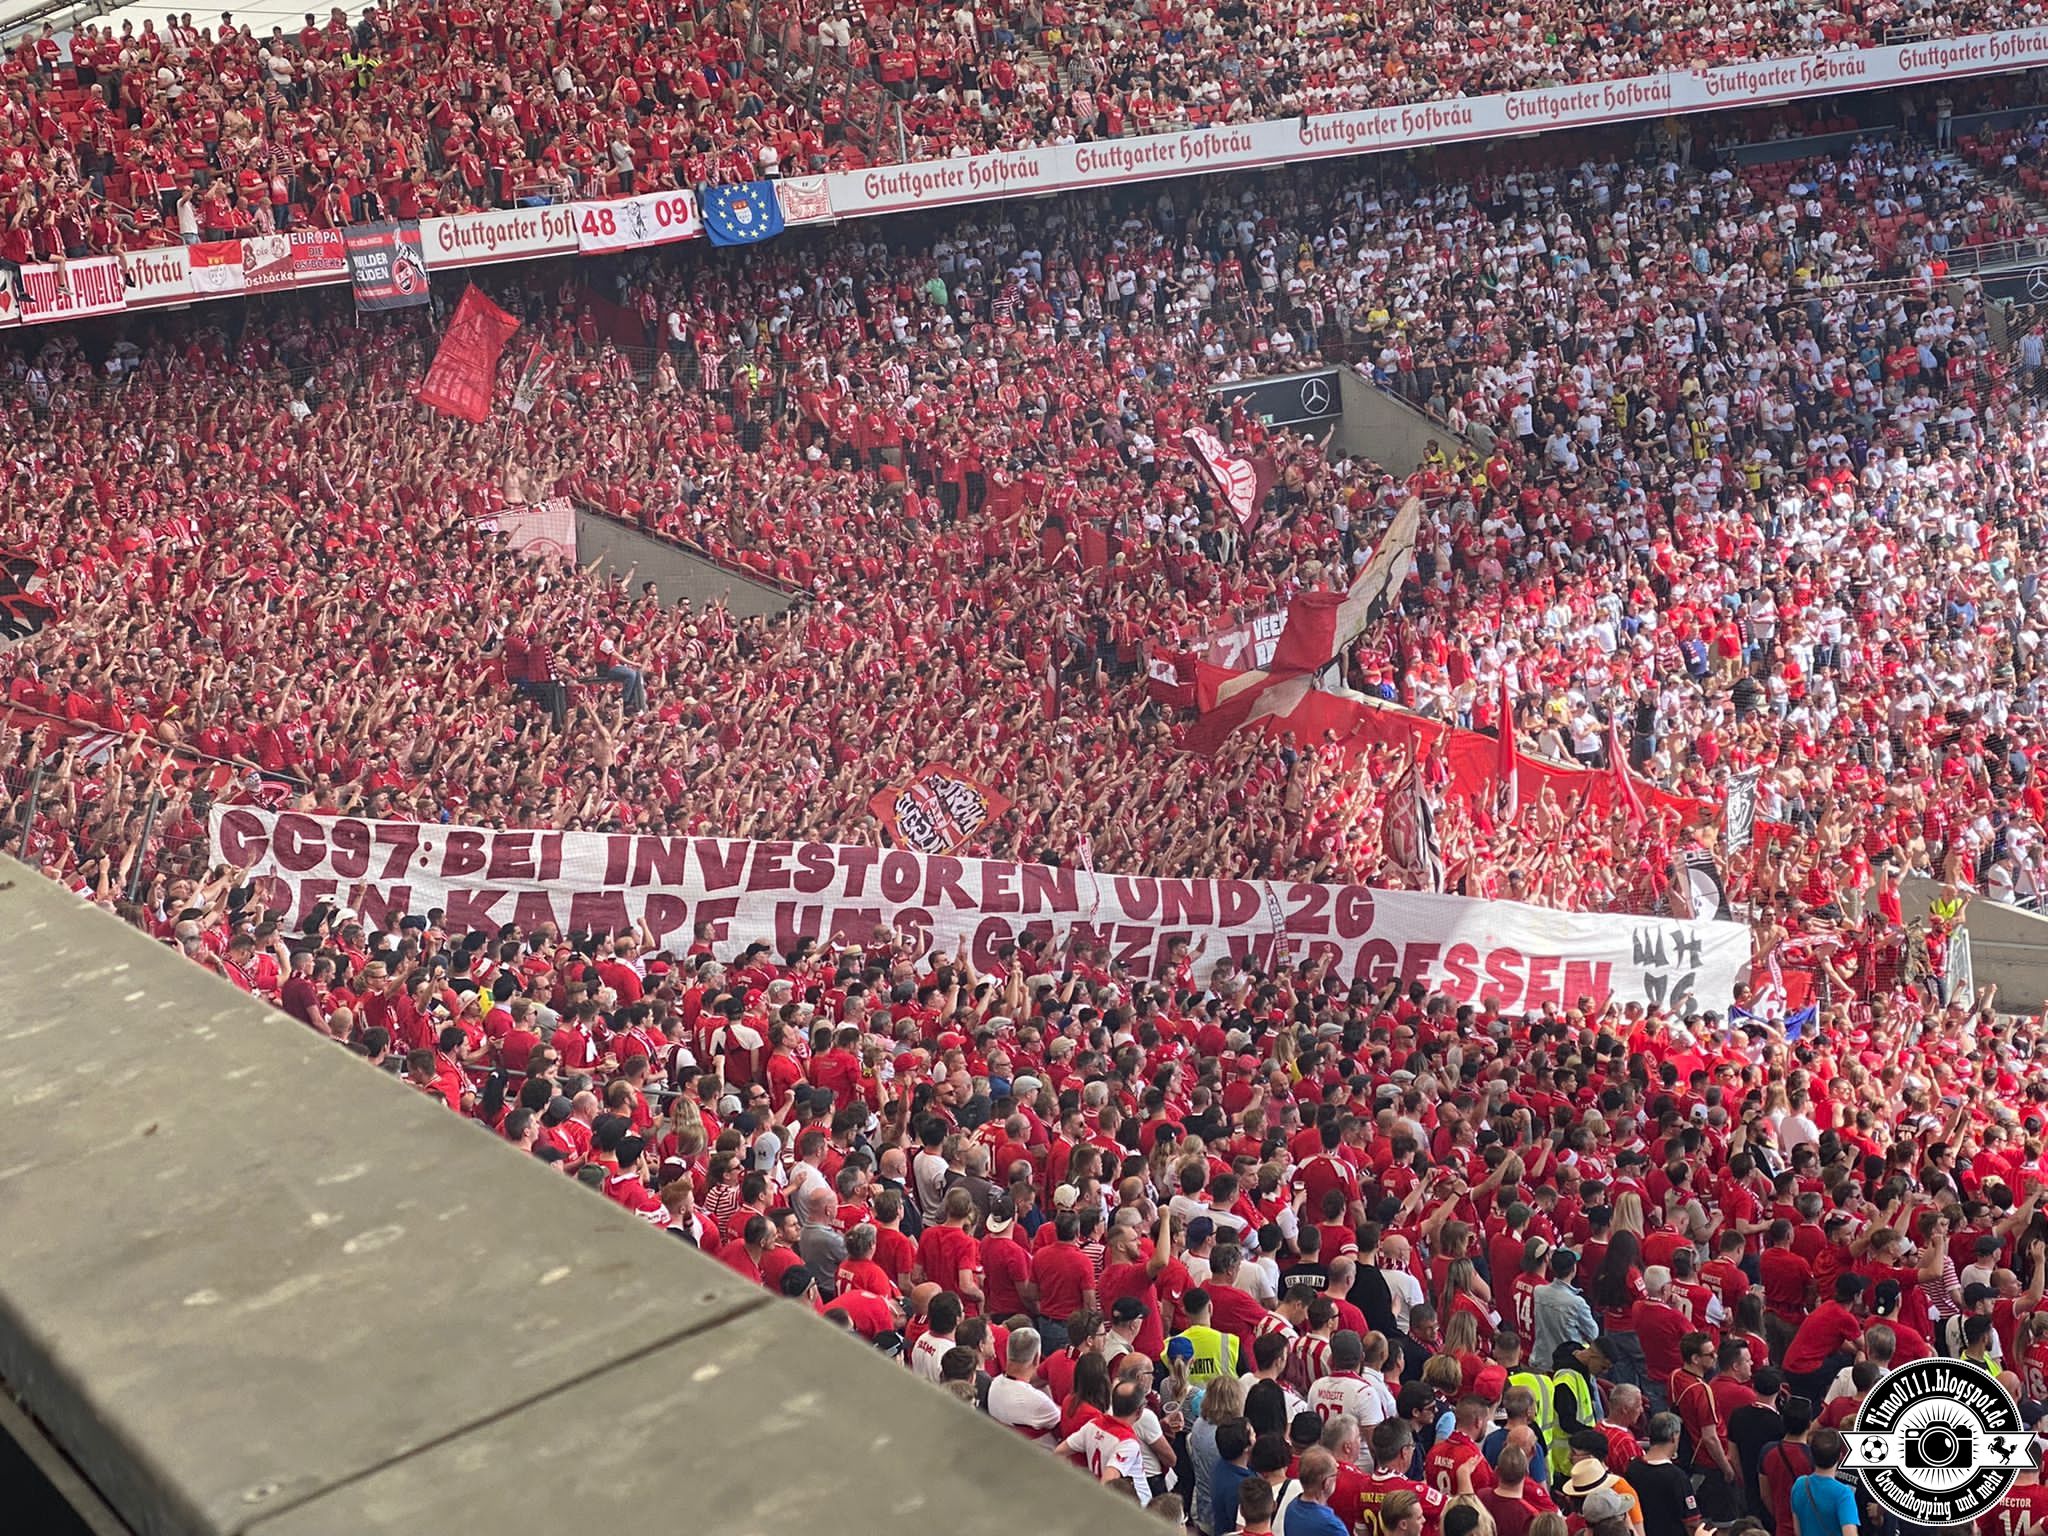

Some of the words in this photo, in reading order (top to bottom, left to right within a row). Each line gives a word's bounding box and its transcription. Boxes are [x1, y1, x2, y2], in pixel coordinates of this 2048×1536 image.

[1898, 41, 1986, 72] Stuttgarter
[1990, 31, 2048, 62] Hofbräu
[1505, 91, 1600, 122] Stuttgarter
[1604, 79, 1671, 111] Hofbräu
[1704, 66, 1797, 97] Stuttgarter
[1299, 116, 1398, 147] Stuttgarter
[1403, 103, 1472, 137] Hofbräu
[1075, 144, 1175, 175] Stuttgarter
[1181, 131, 1252, 165] Hofbräu
[864, 169, 964, 200] Stuttgarter
[968, 155, 1040, 192] Hofbräu
[290, 231, 339, 245] EUROPA
[439, 217, 537, 252] Stuttgarter
[541, 209, 578, 243] Hof
[581, 209, 616, 239] 48
[656, 197, 688, 228] 09
[121, 254, 183, 293] ofbräu
[603, 834, 1077, 914] INVESTOREN
[1113, 877, 1262, 930] UND
[1286, 884, 1376, 939] 2G
[443, 887, 740, 964] KAMPF
[775, 899, 935, 961] UMS
[1226, 933, 1612, 1016] VERGESSEN
[1513, 1292, 1533, 1331] 14
[2000, 1497, 2032, 1508] HECTOR
